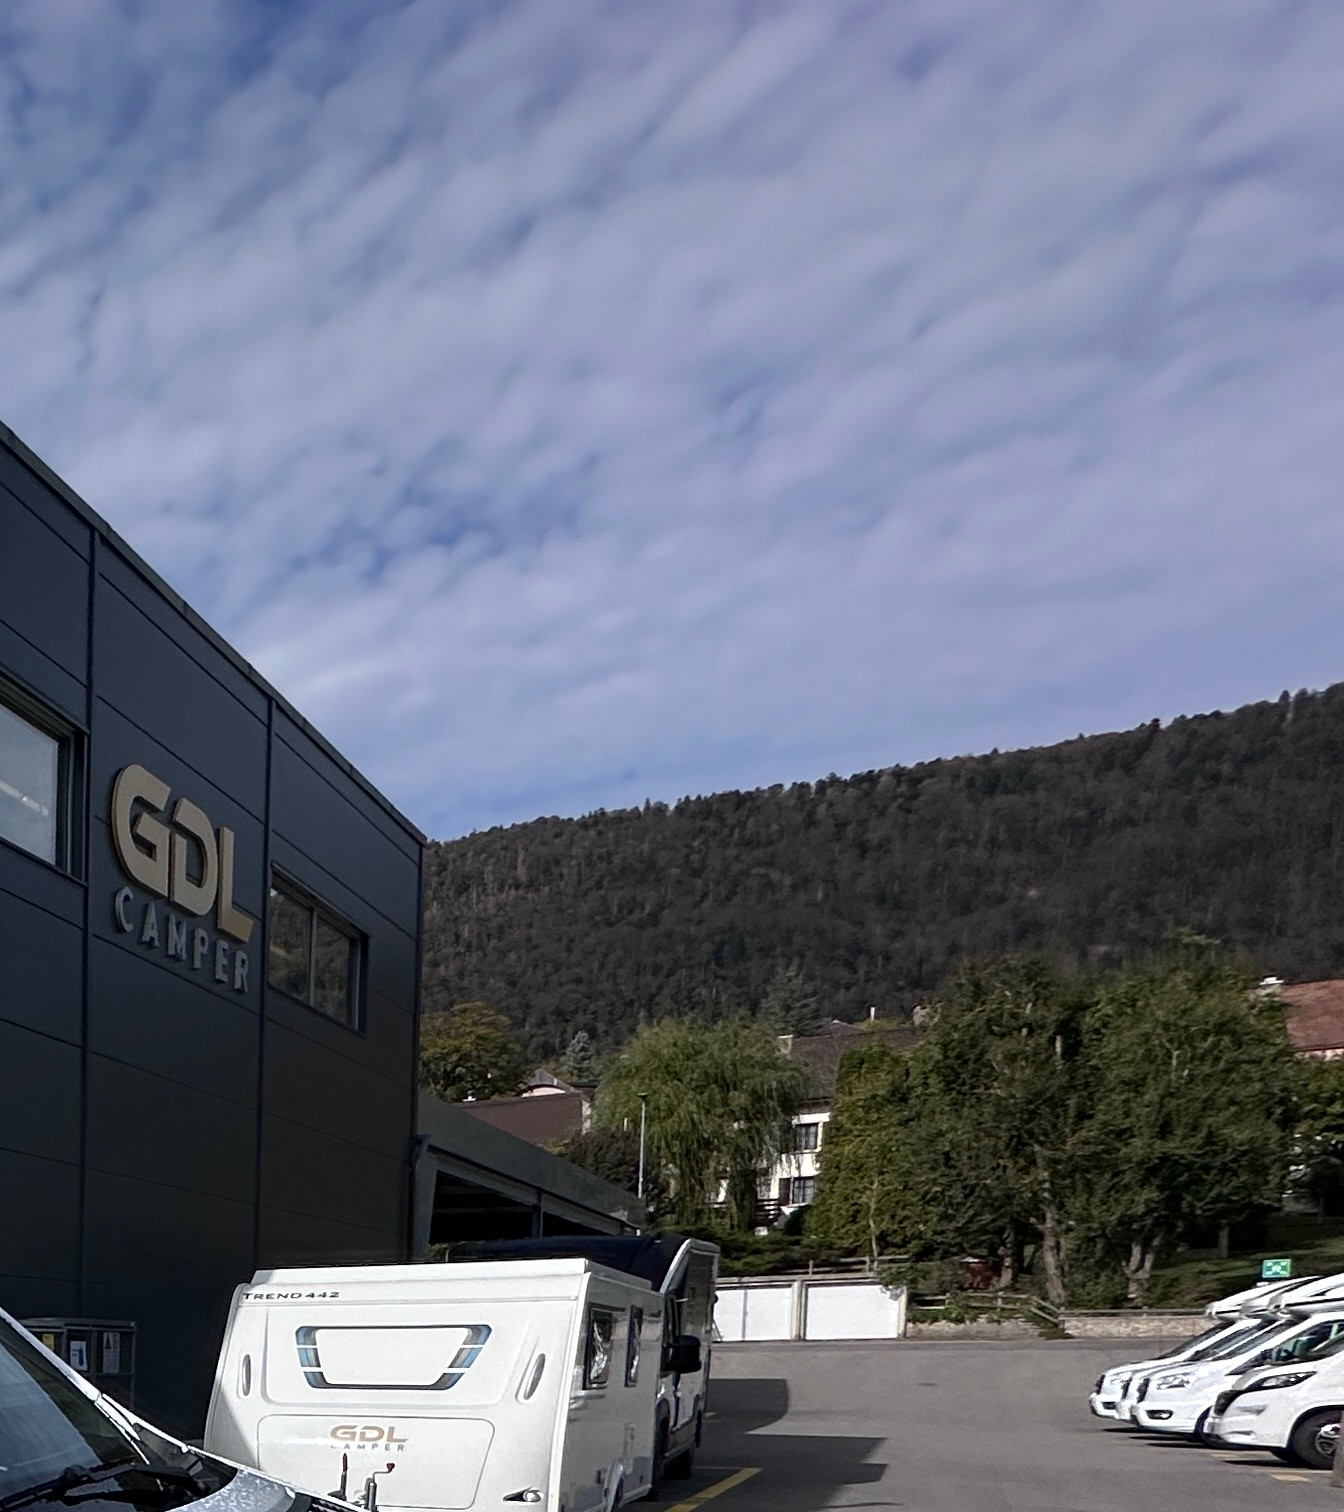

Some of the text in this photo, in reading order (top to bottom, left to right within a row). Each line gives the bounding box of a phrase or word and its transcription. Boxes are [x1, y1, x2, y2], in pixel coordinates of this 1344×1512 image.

[113, 764, 254, 943] GDL
[115, 886, 249, 993] CAMPER
[243, 1291, 340, 1300] TREND 442
[330, 1425, 408, 1443] GDL
